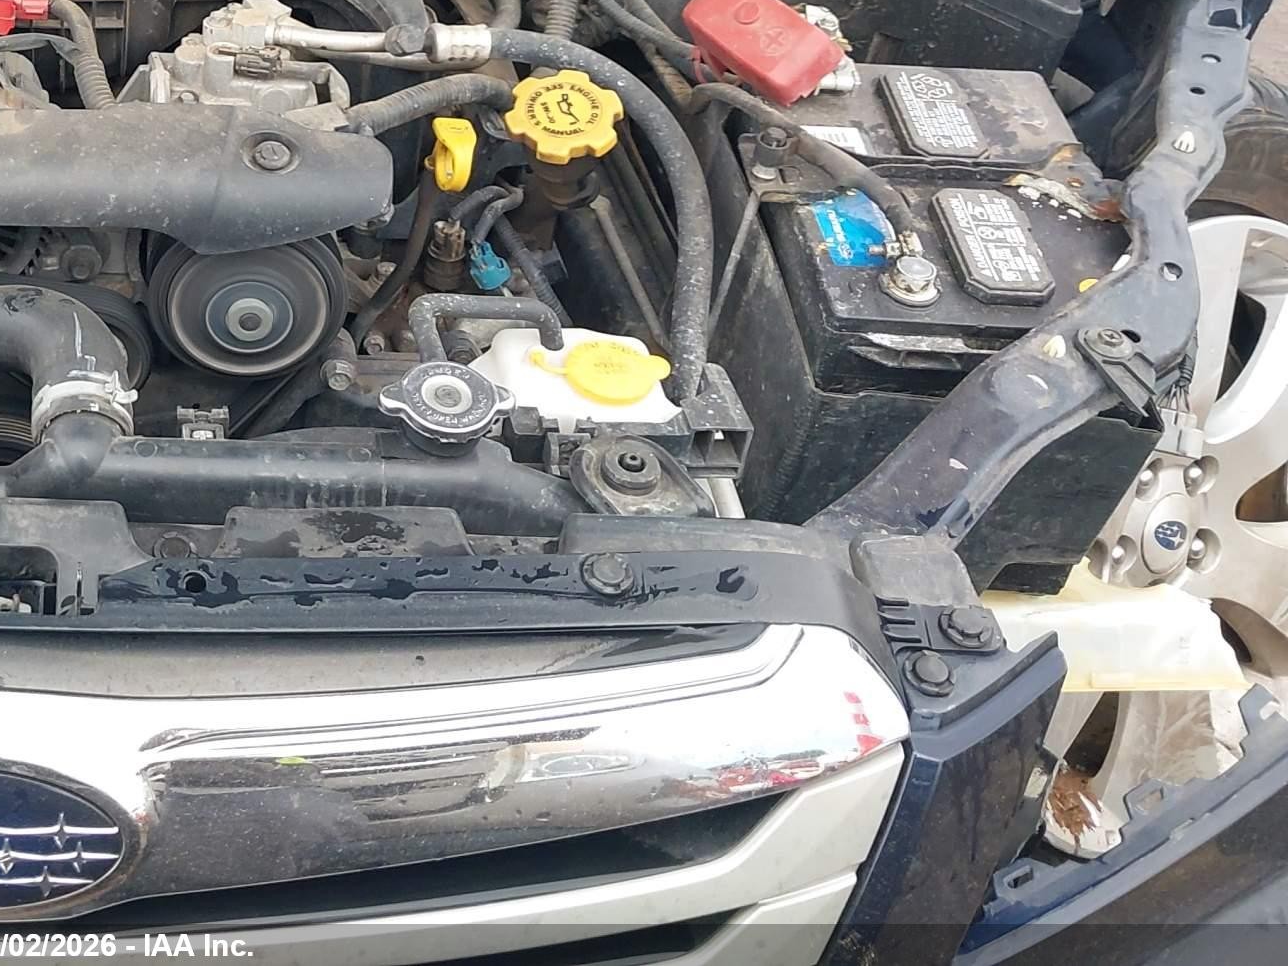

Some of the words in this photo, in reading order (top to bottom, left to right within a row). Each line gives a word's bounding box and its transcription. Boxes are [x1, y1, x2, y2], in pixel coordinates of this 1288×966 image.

[544, 83, 564, 92] SEE
[569, 84, 600, 111] ENGINE
[586, 113, 600, 125] OIL
[542, 126, 585, 136] MANUAL
[948, 197, 971, 228] POISON
